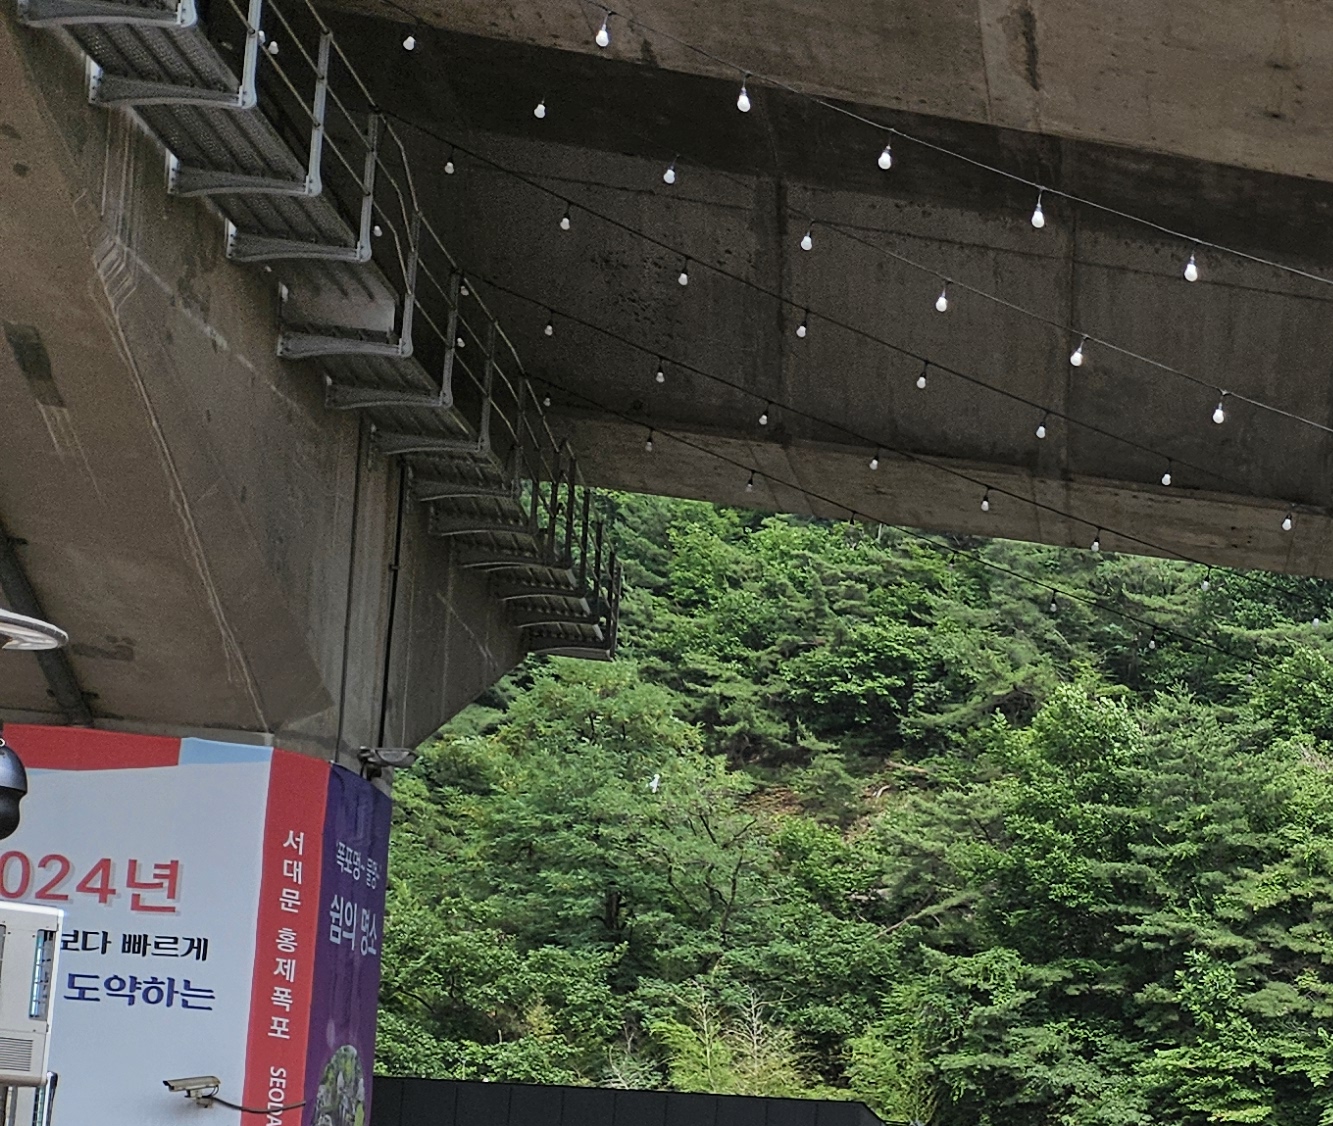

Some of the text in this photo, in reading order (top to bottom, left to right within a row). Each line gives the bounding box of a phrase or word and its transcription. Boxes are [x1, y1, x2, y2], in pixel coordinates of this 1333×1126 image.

[121, 934, 209, 962] 빠르게
[268, 830, 304, 1039] 서대문 홍제폭포
[360, 908, 377, 956] 명소
[63, 973, 215, 1011] 도약하는
